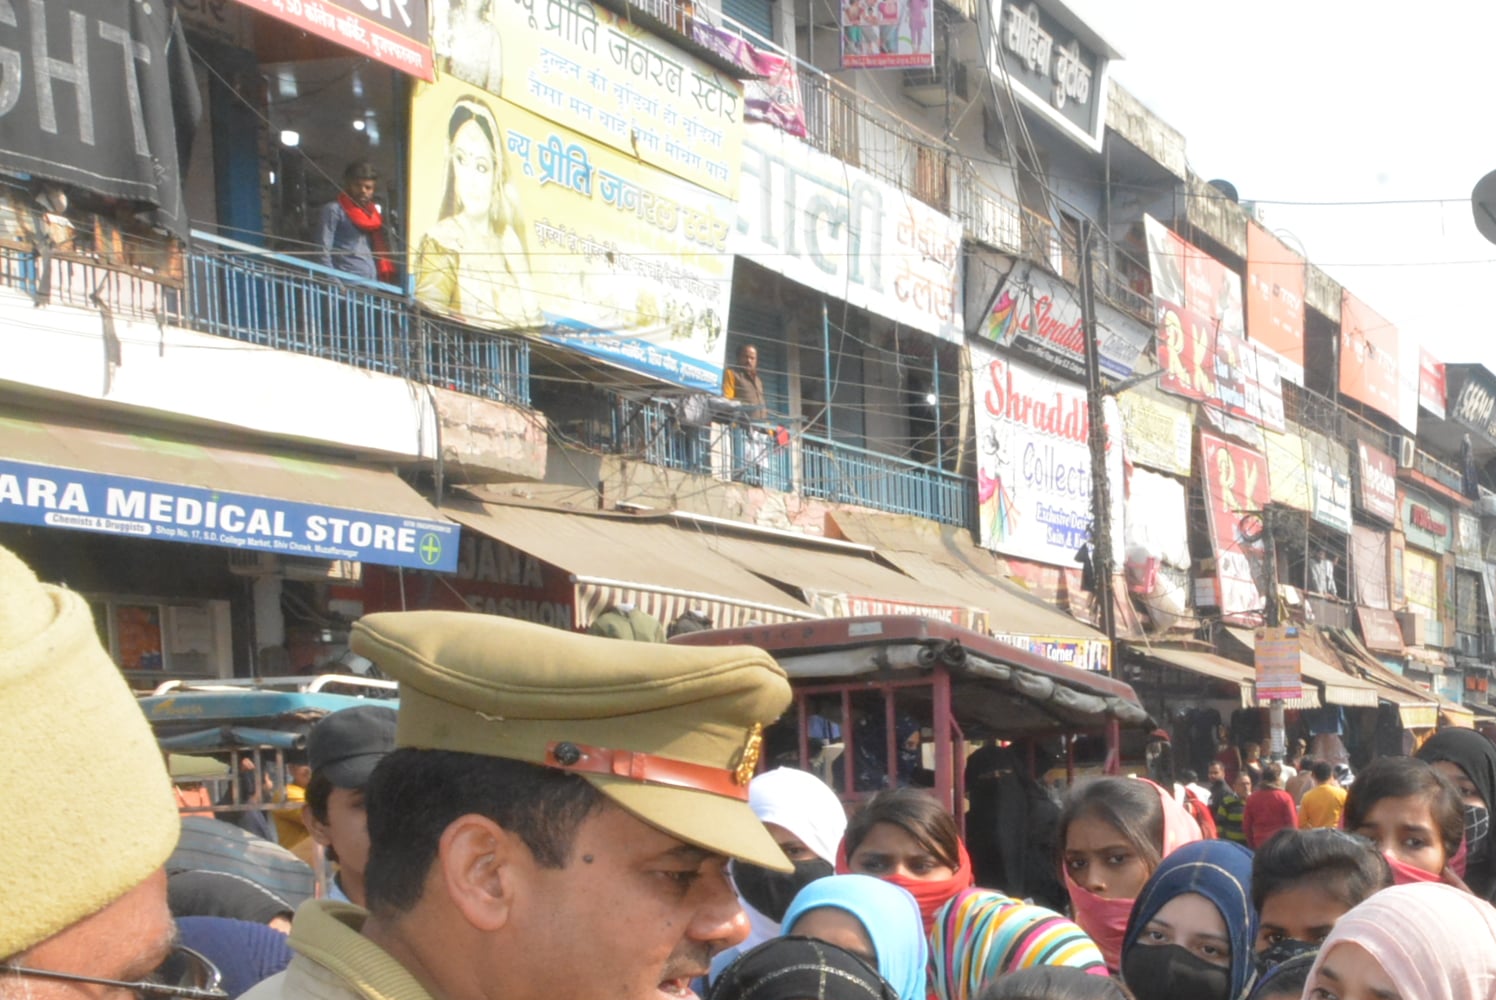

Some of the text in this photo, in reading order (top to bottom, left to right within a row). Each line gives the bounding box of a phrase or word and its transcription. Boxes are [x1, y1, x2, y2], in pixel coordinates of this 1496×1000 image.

[607, 27, 685, 97] जनरल
[536, 134, 595, 200] प्रीति
[52, 513, 147, 533] Chemists & Druggists
[106, 486, 294, 538] MEDICAL
[305, 512, 417, 554] STORE
[155, 524, 177, 538] Shop
[176, 527, 190, 539] No.
[219, 533, 247, 547] College
